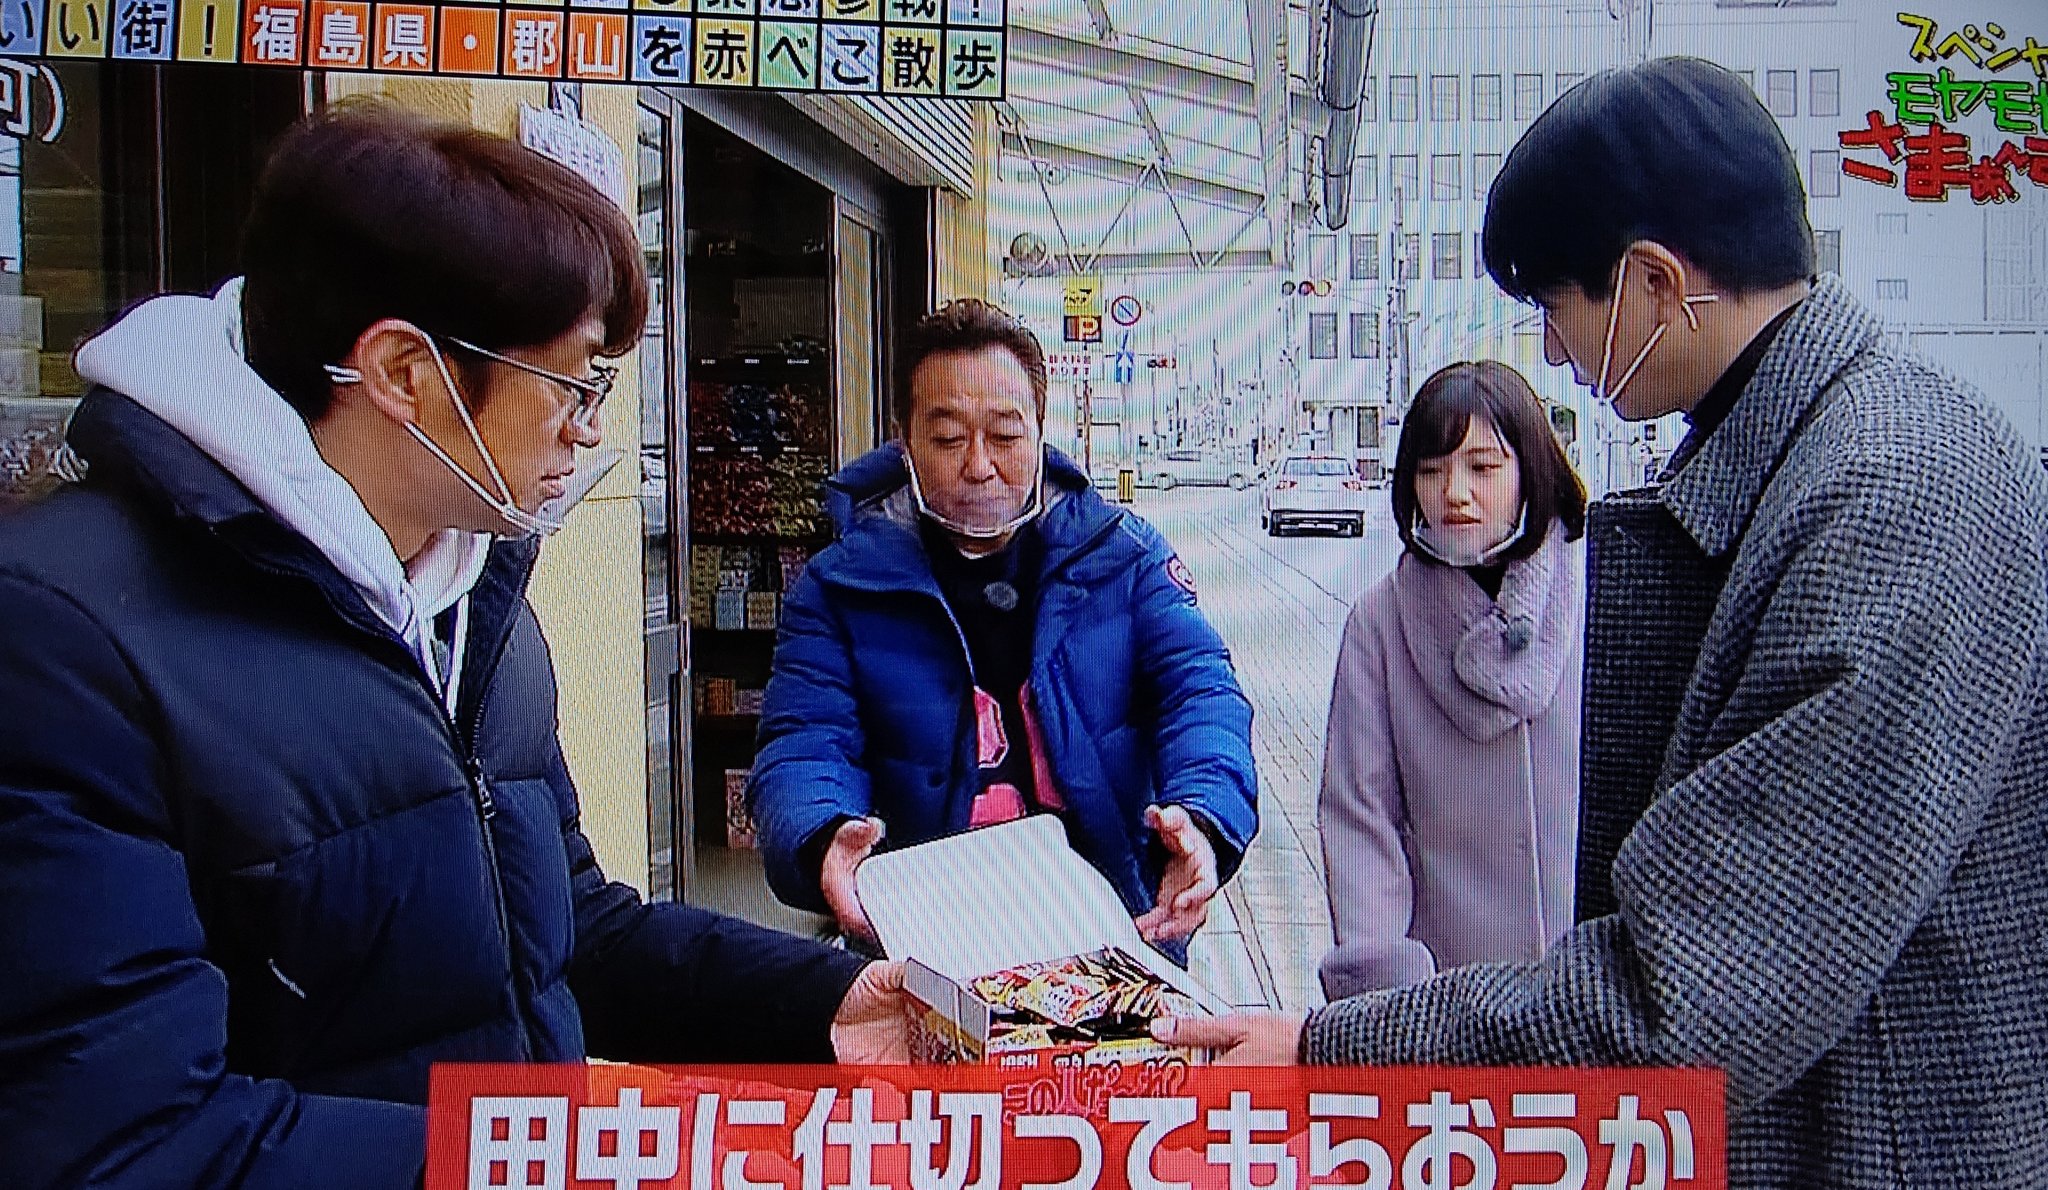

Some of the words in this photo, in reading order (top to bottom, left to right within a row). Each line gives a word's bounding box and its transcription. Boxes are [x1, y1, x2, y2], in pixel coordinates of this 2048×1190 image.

[468, 1088, 1695, 1190] 田中に仕切ってもらおうか
